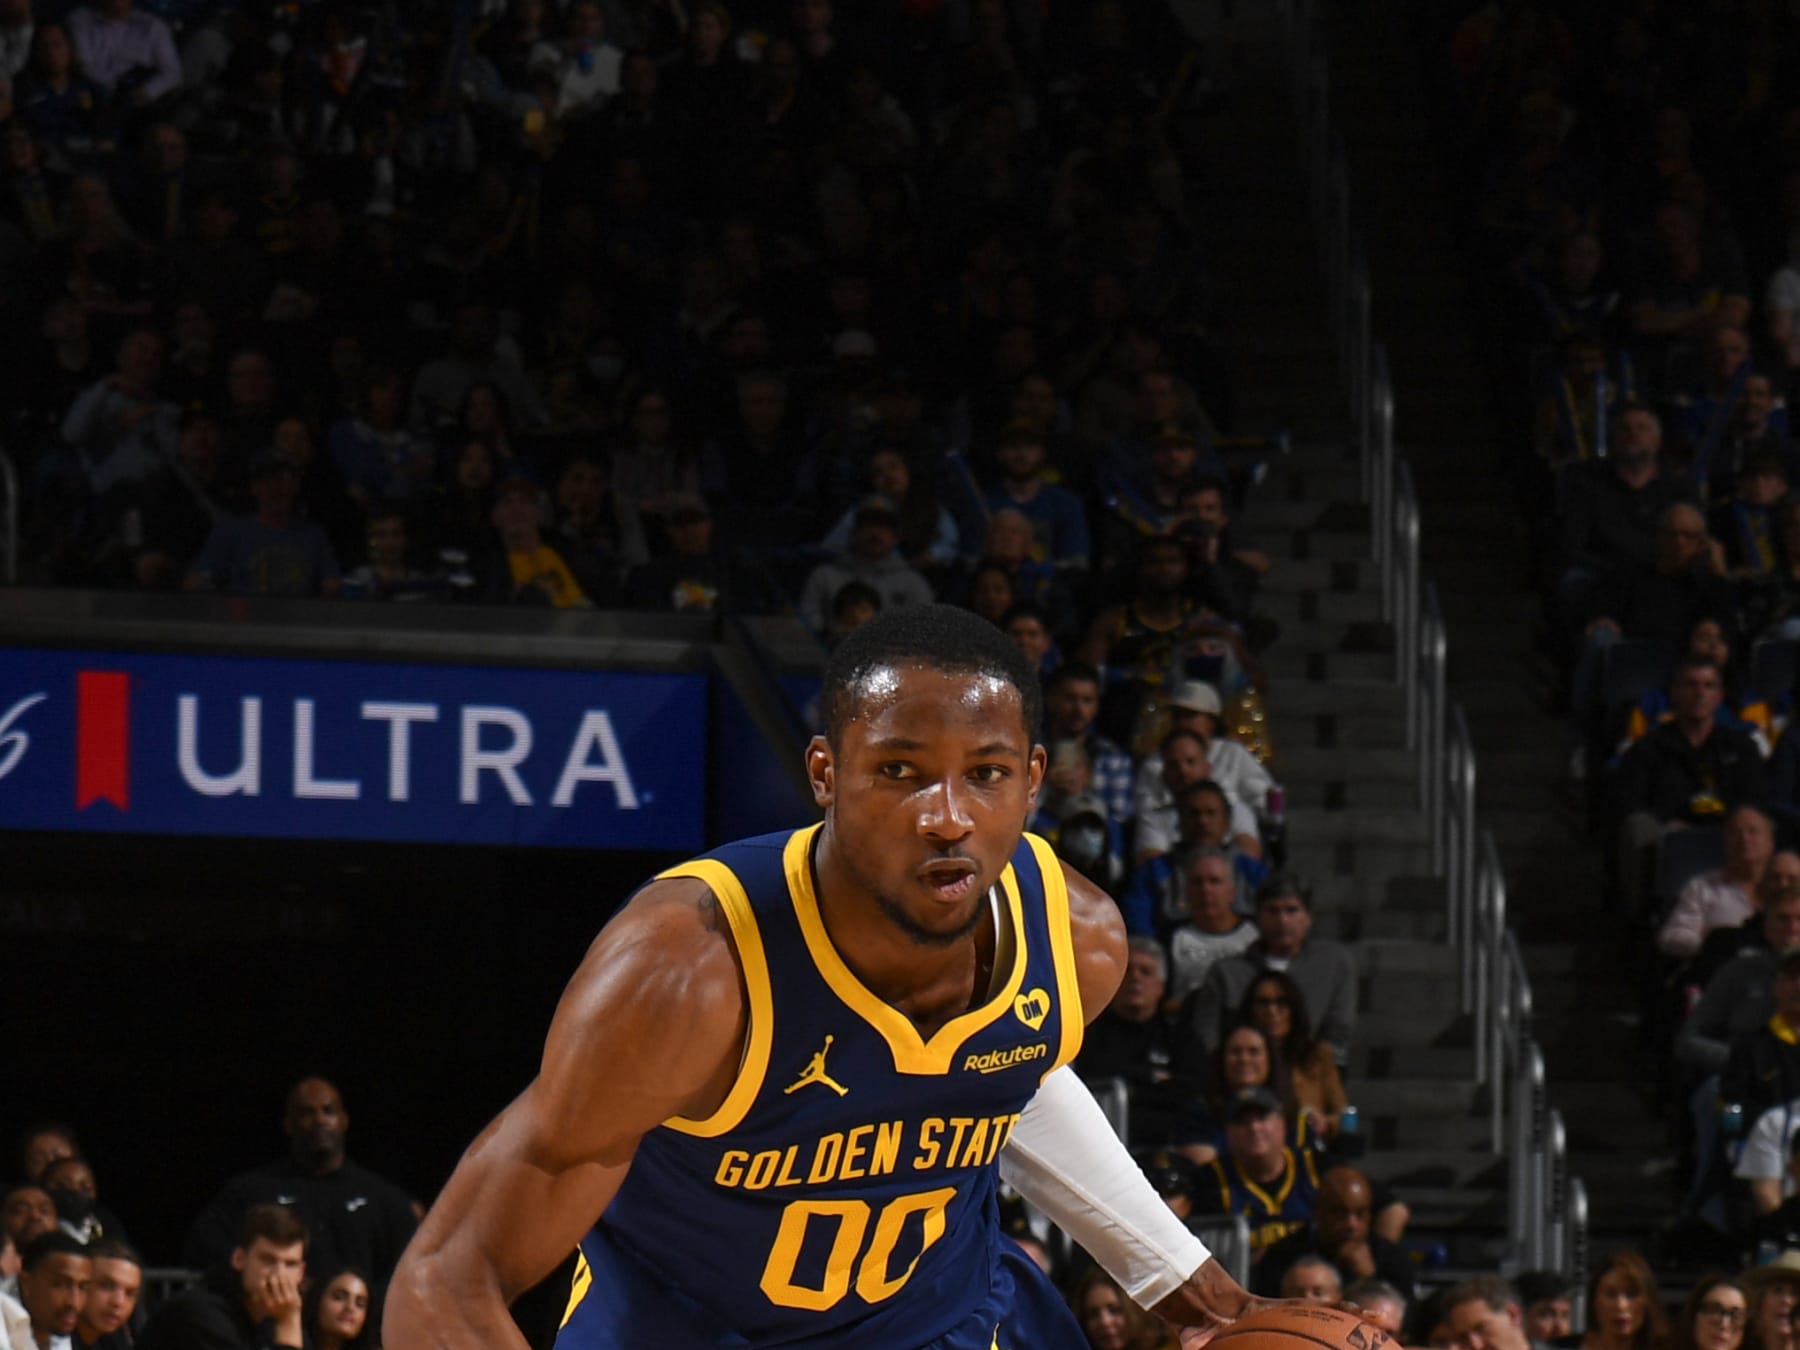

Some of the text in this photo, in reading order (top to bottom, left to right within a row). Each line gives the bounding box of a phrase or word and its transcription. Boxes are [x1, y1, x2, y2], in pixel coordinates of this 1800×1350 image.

[177, 693, 641, 810] ULTRA
[1021, 998, 1043, 1021] DM
[963, 1043, 1047, 1073] Rakuten
[714, 1120, 904, 1190] GOLDEN
[759, 1186, 958, 1312] 00
